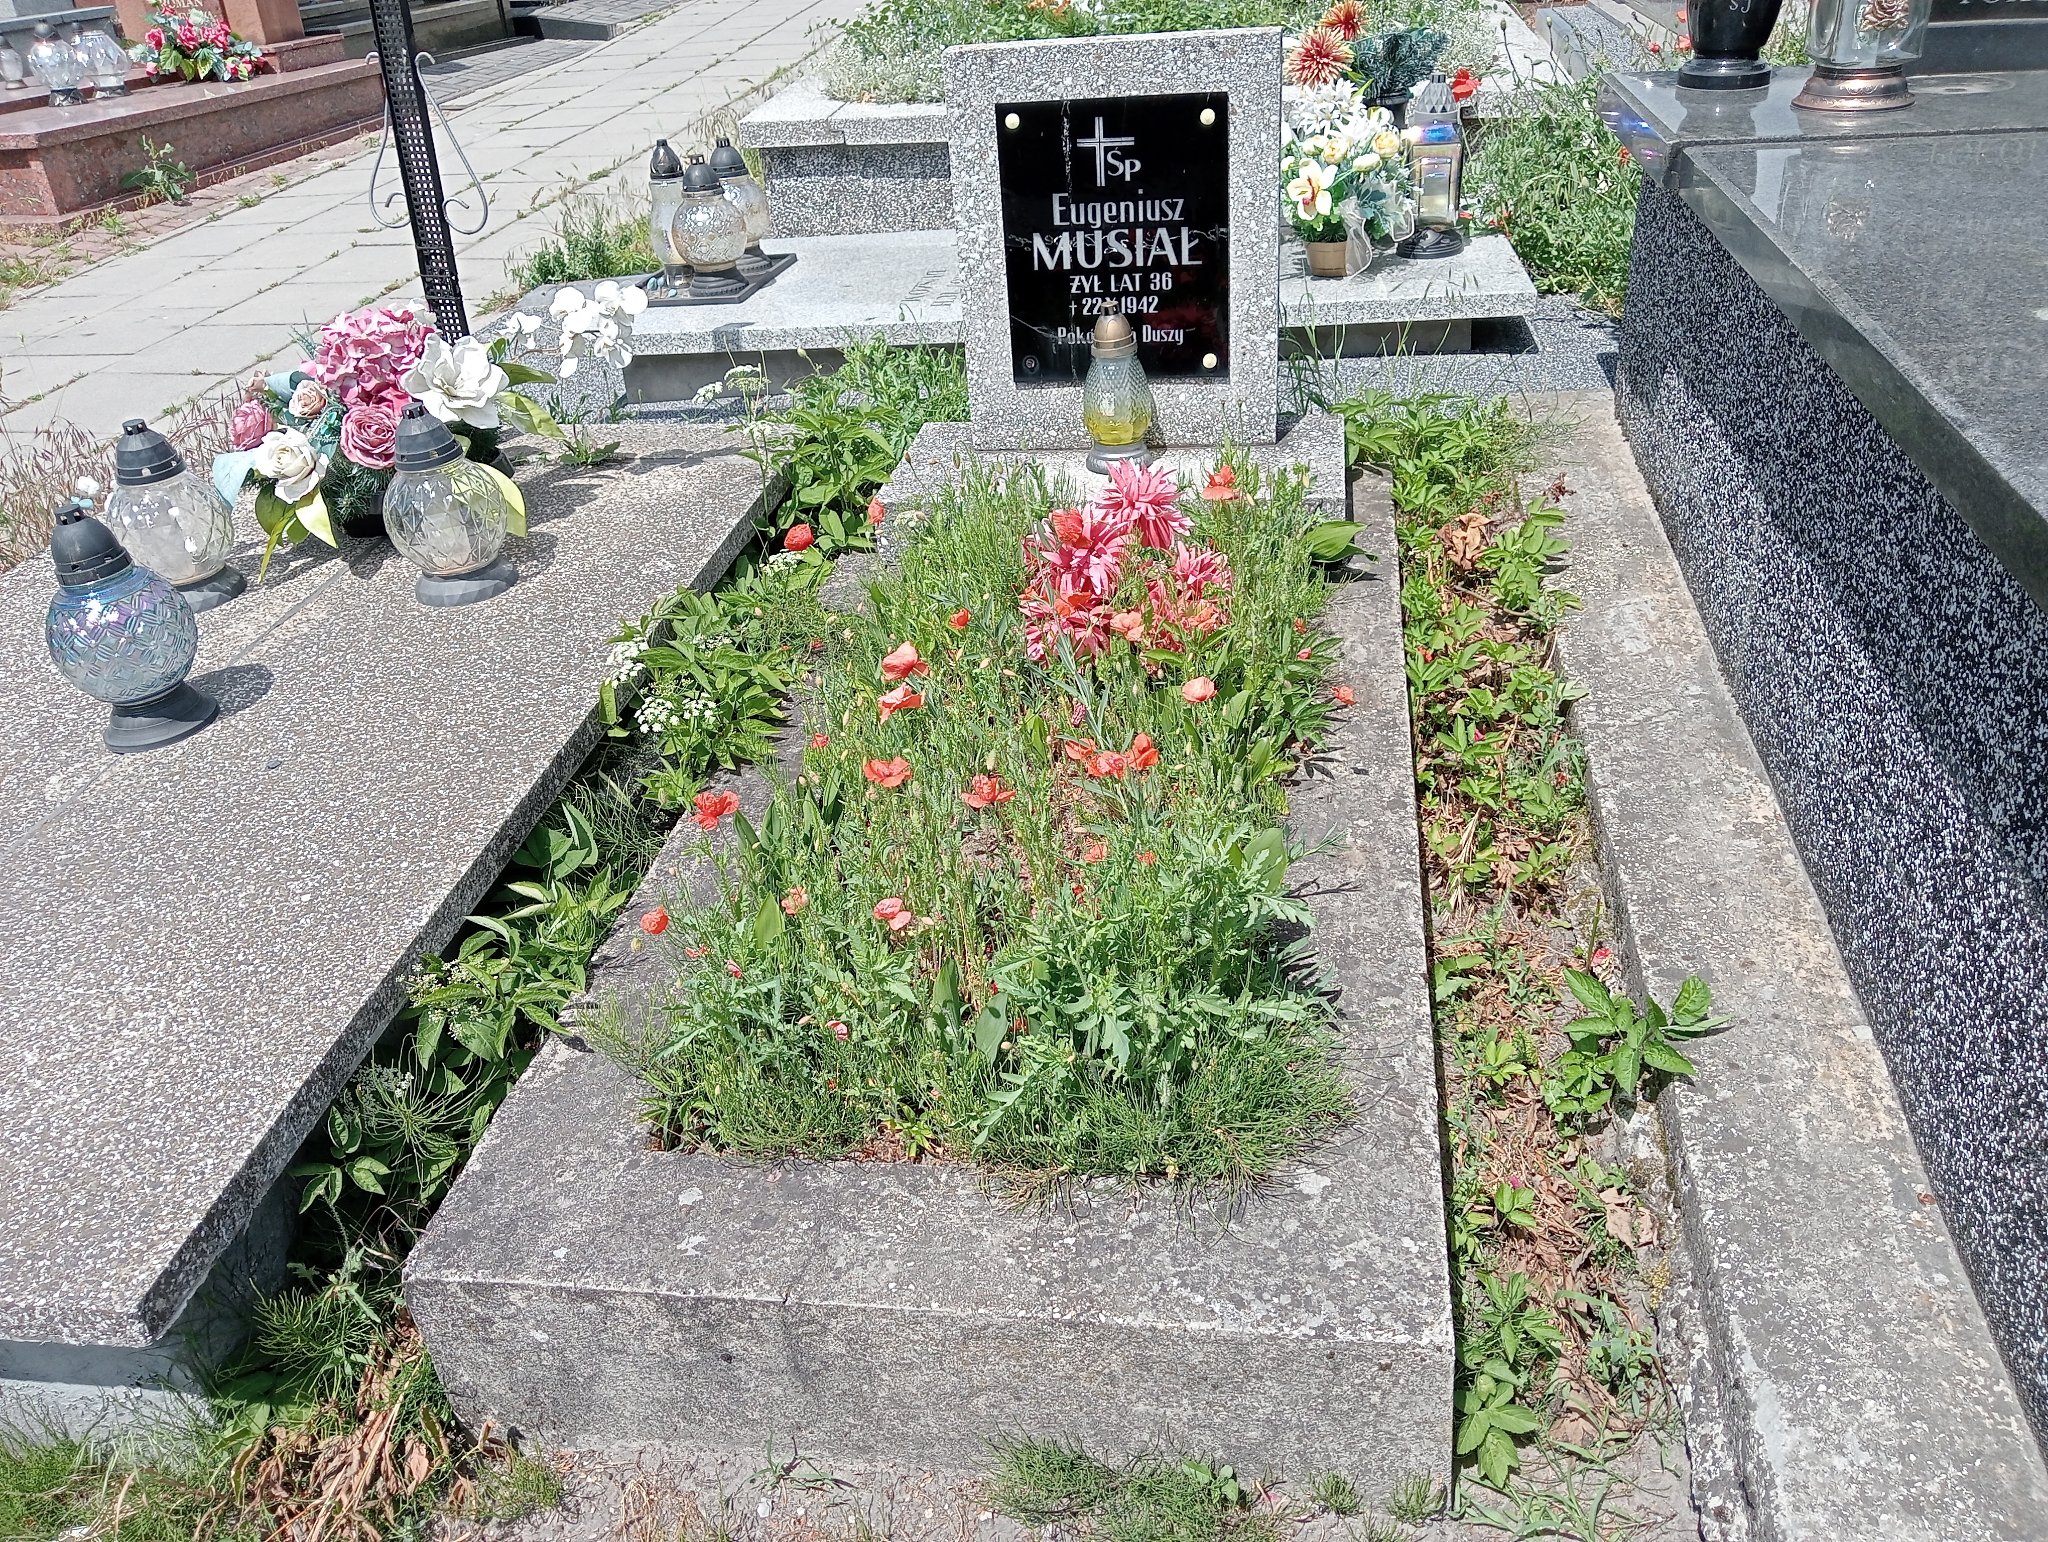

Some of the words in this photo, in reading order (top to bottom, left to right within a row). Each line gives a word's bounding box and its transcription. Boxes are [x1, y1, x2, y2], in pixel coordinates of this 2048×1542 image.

[1052, 189, 1185, 229] Eugeniusz
[1033, 226, 1203, 271] MUSIAŁ
[1110, 273, 1143, 293] LAT
[1149, 272, 1173, 291] 36
[1121, 295, 1159, 314] 1942
[1057, 326, 1095, 345] Pokó
[1142, 324, 1184, 345] Duszy
